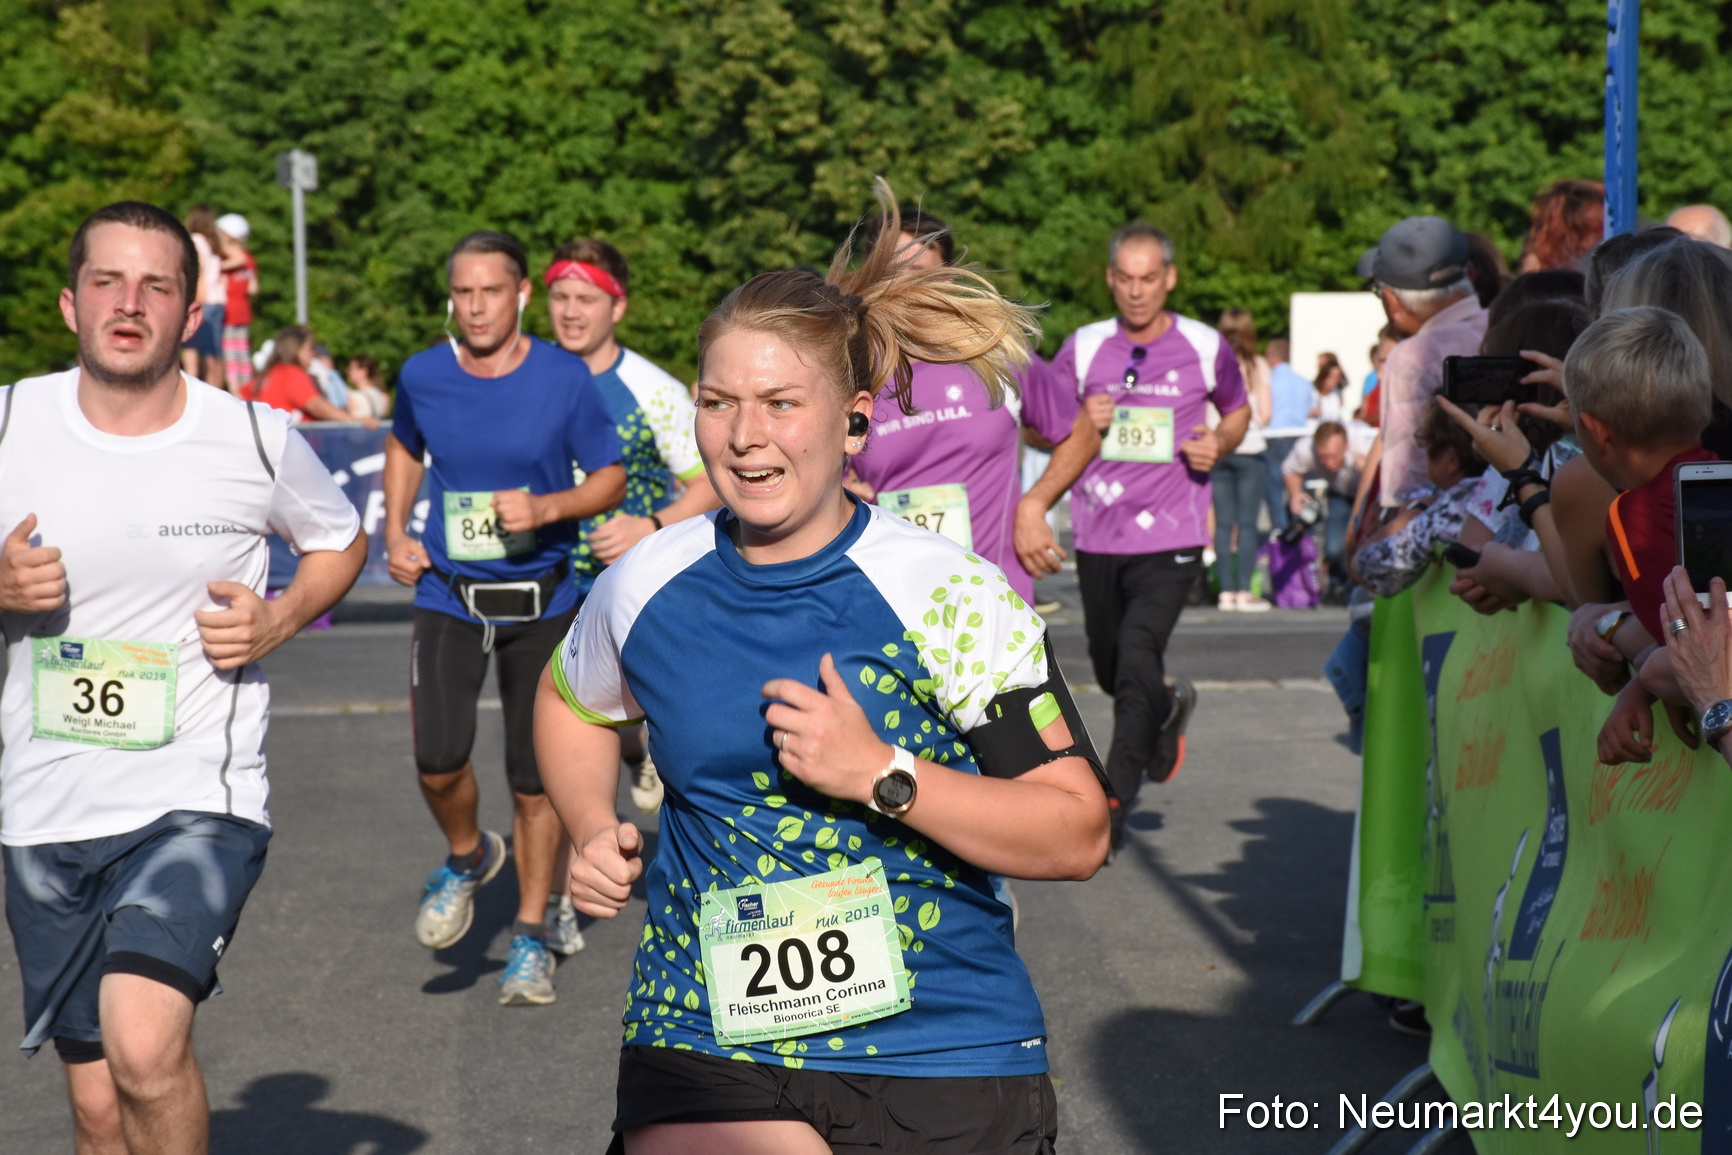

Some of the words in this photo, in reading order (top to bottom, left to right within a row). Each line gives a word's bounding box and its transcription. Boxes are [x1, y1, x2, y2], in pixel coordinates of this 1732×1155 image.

[876, 419, 901, 436] WIR
[903, 410, 935, 429] SIND
[936, 405, 972, 421] LILA.
[1118, 426, 1156, 446] 893
[158, 522, 238, 536] auctores
[139, 671, 167, 680] 2019
[72, 677, 124, 717] 36
[62, 714, 91, 728] Weigl
[94, 718, 136, 730] Michael
[103, 729, 126, 738] GmbH
[811, 876, 846, 889] Gesunde
[828, 887, 852, 899] laufen
[854, 884, 883, 899] länger!
[726, 911, 795, 934] firmenlauf
[845, 904, 880, 923] 2019
[740, 929, 856, 998] 208
[728, 994, 822, 1017] Fleischmann
[825, 978, 887, 1001] Corinna
[773, 1006, 824, 1024] Bionorica
[826, 1003, 841, 1014] SE
